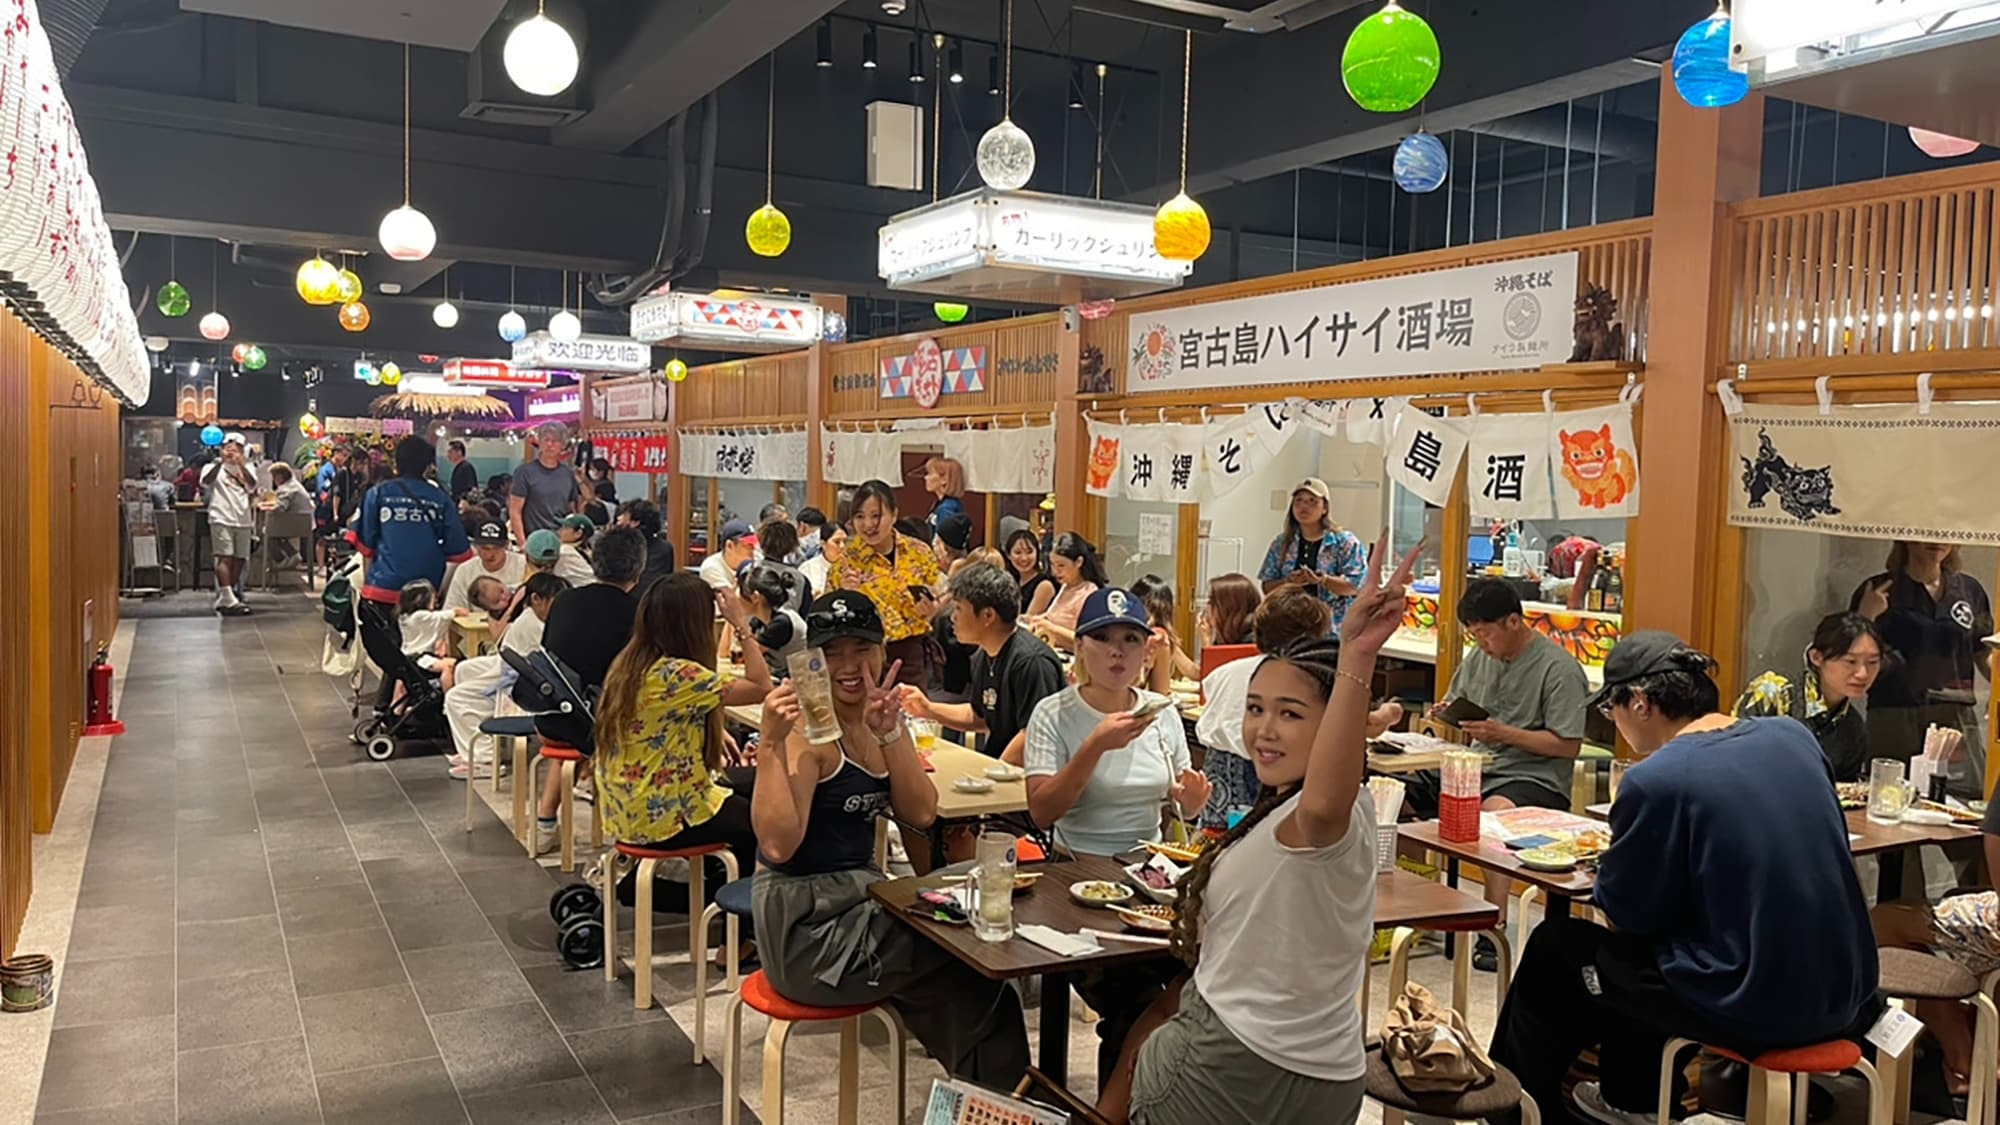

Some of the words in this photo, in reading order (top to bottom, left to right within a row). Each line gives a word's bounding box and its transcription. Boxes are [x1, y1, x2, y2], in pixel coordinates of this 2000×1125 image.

[1494, 270, 1554, 293] 沖縄そば
[1179, 298, 1474, 370] 宮古島ハイサイ酒場
[548, 341, 640, 363] 欢迎光临
